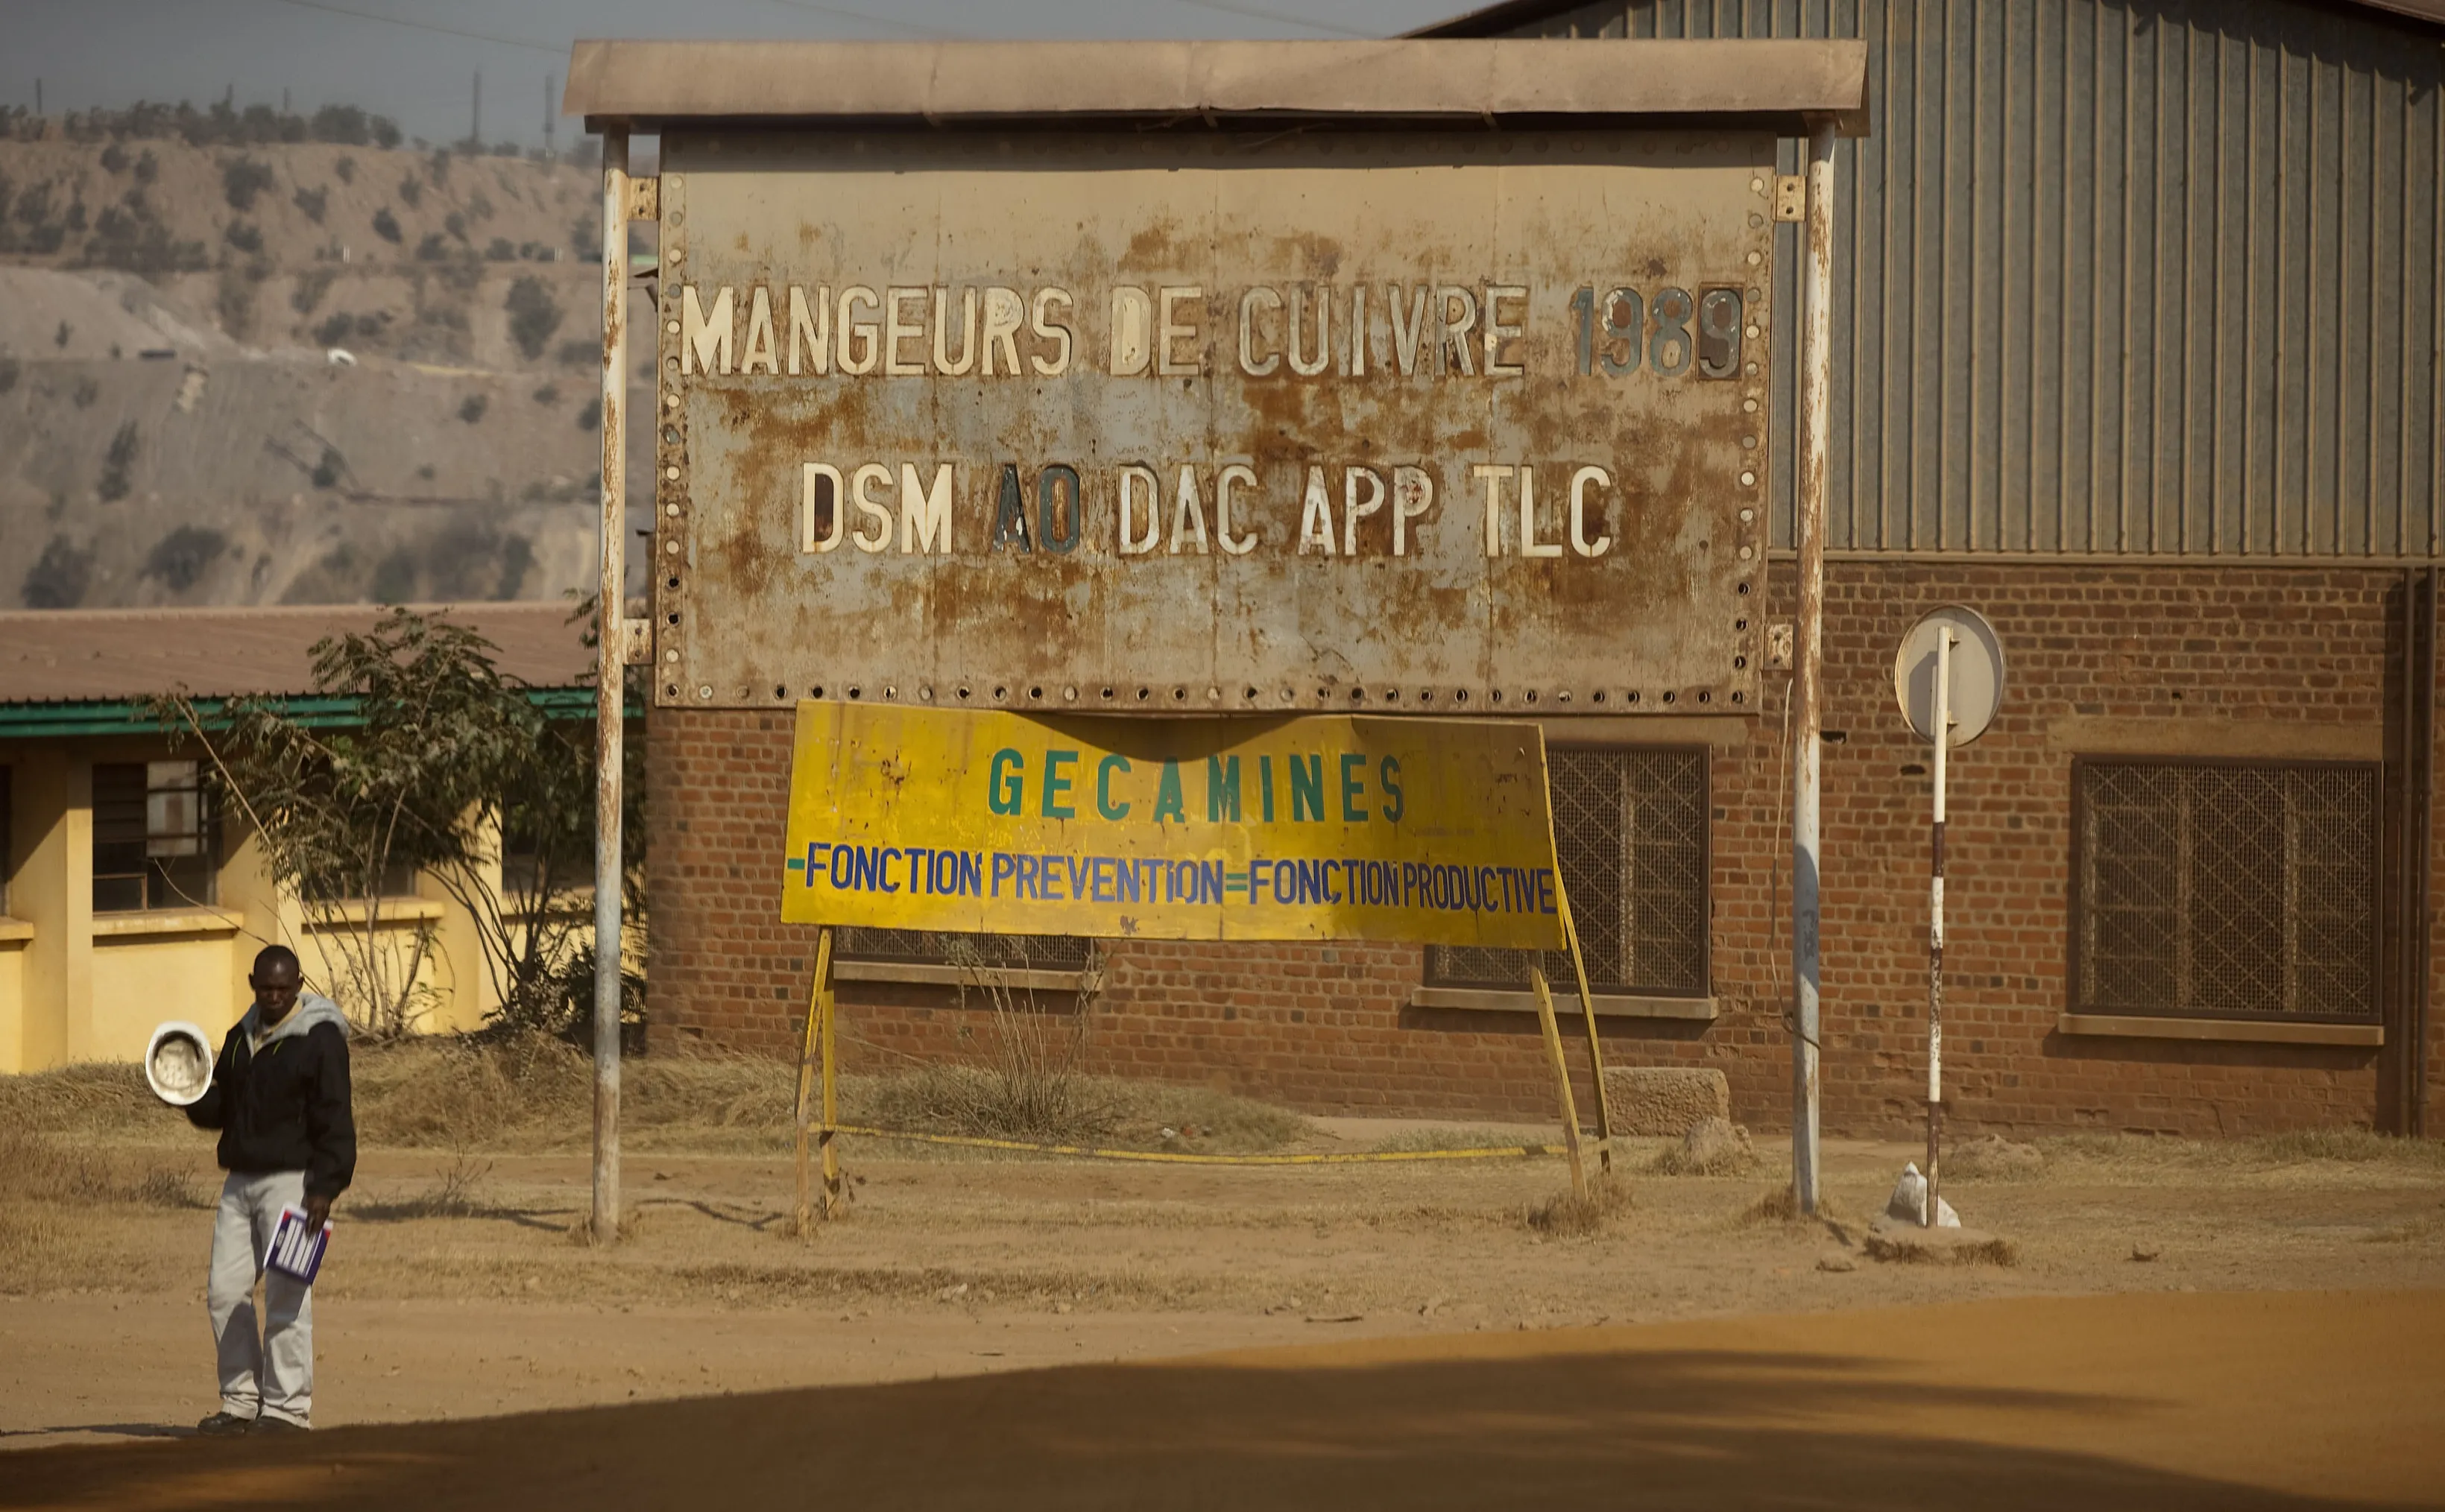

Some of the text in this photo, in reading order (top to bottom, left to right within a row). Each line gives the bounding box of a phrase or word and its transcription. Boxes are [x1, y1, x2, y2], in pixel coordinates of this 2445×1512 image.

[681, 285, 1743, 379] MANGEURS DE CUIVRE 1989
[802, 461, 1612, 559] DSM AO DAC APP TLC
[988, 747, 1404, 823] GECAMINES
[1402, 862, 1558, 914] PRODUCTIVE
